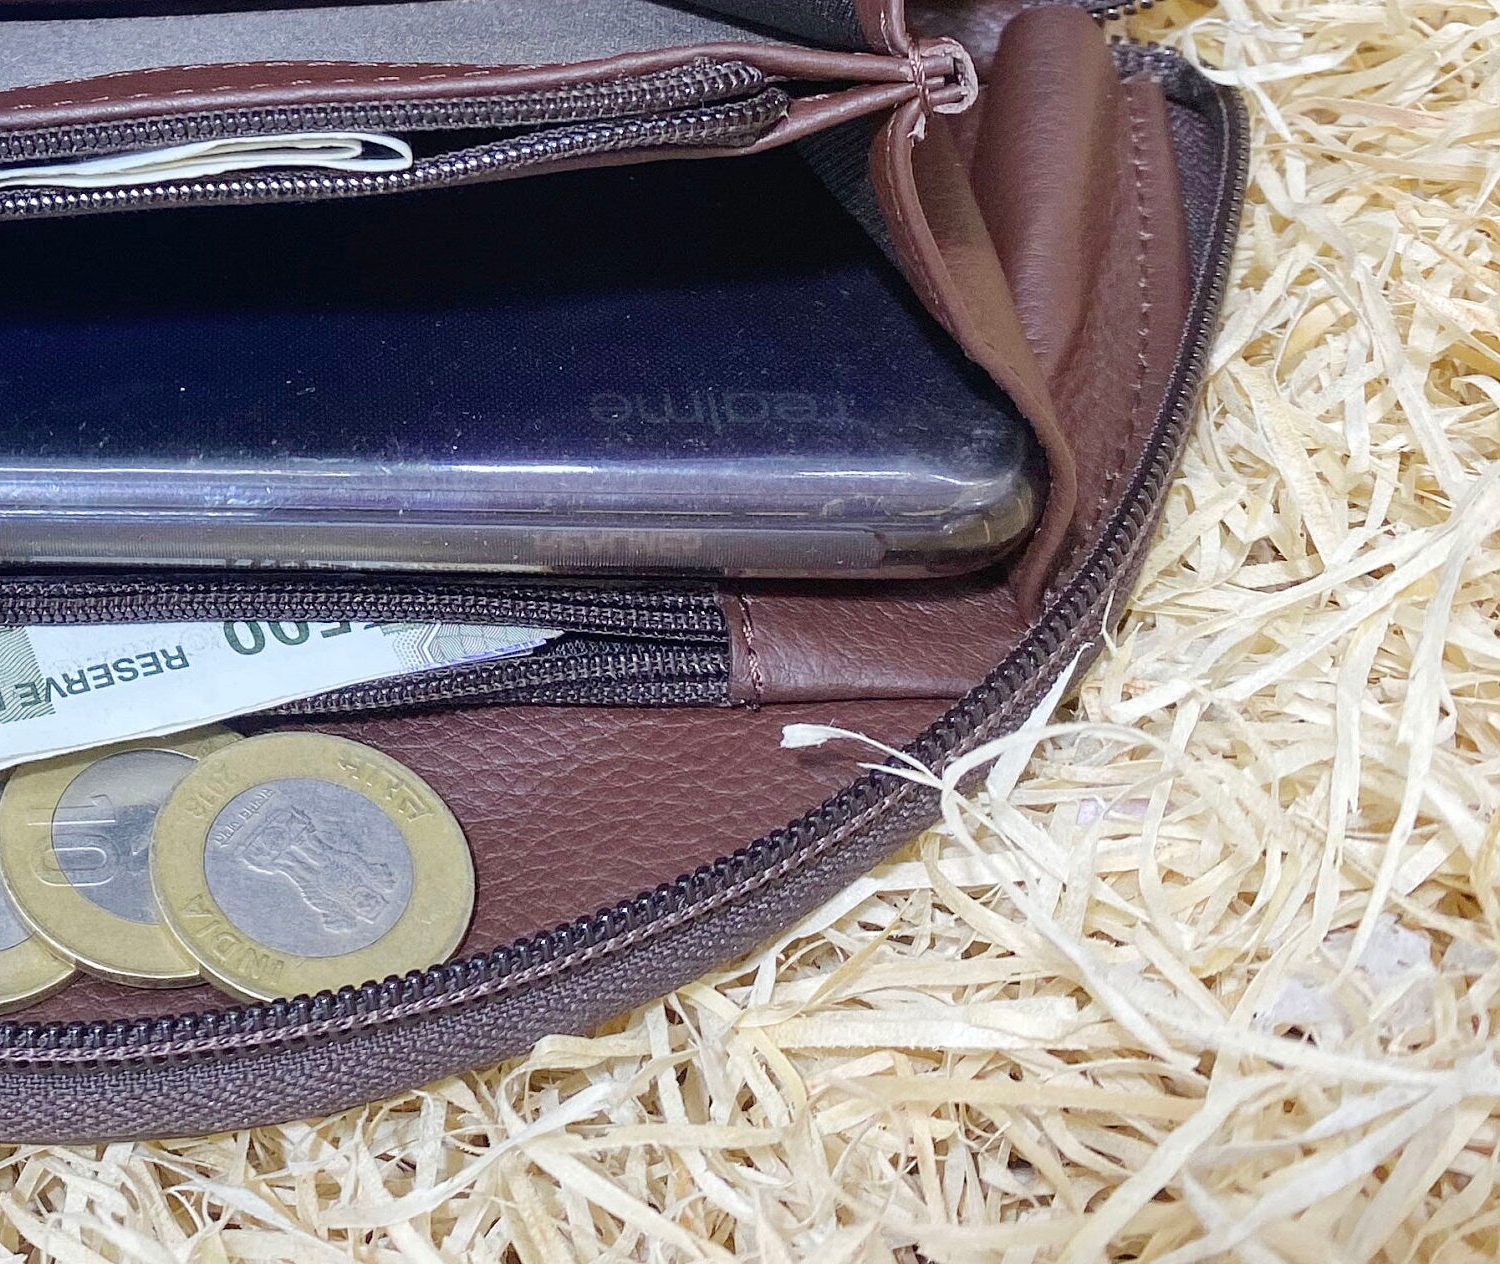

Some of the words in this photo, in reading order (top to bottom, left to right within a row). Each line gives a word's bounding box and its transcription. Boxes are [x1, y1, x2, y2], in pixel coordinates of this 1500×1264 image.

[589, 389, 848, 434] realme
[15, 644, 190, 708] RESERVE
[26, 791, 117, 888] 10
[181, 893, 284, 979] INDIA
